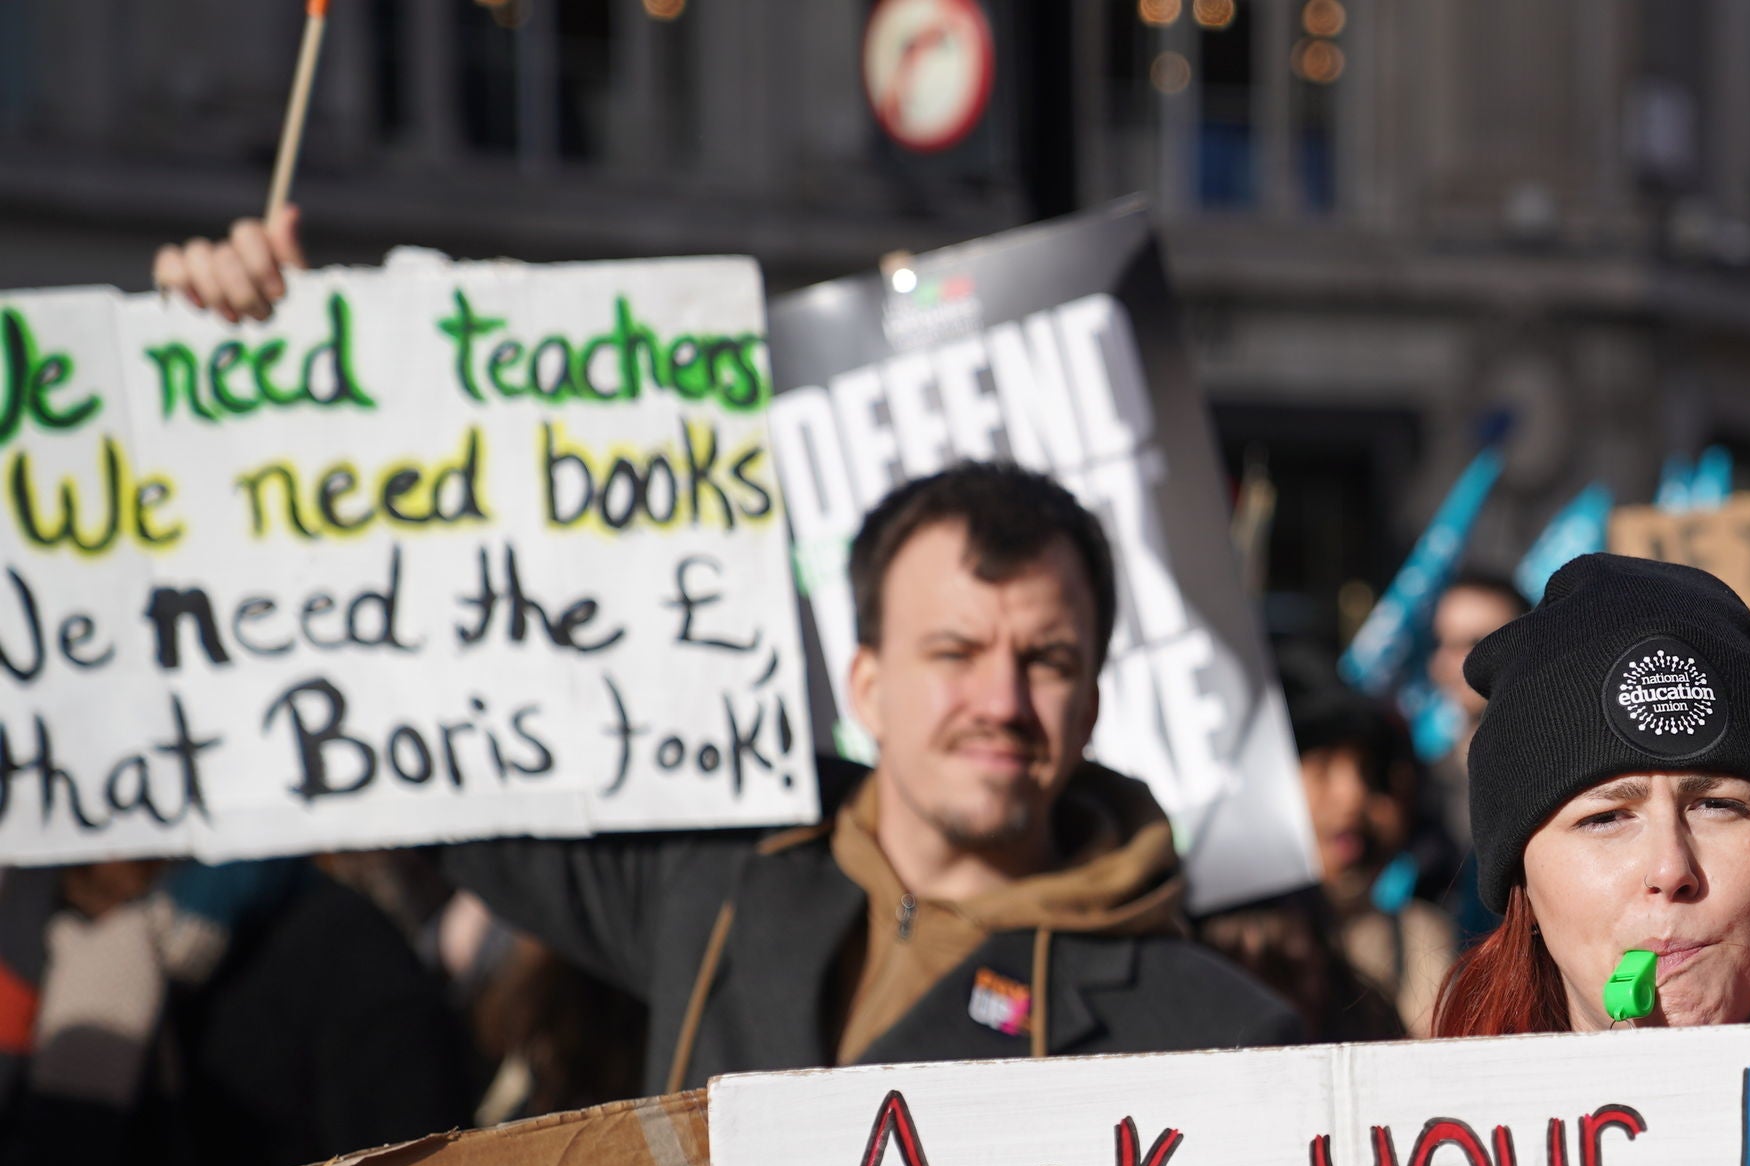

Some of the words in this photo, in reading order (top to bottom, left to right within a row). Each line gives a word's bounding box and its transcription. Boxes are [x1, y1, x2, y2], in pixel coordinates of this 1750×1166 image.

[143, 290, 378, 424] need
[433, 287, 770, 412] teachers
[8, 435, 188, 558] We
[234, 424, 490, 540] need
[538, 415, 776, 538] books
[143, 543, 426, 668] need
[453, 542, 629, 657] the
[261, 676, 556, 804] Boris
[600, 668, 796, 803] took!
[1618, 683, 1716, 706] education
[1641, 671, 1690, 685] national
[1652, 700, 1688, 713] union
